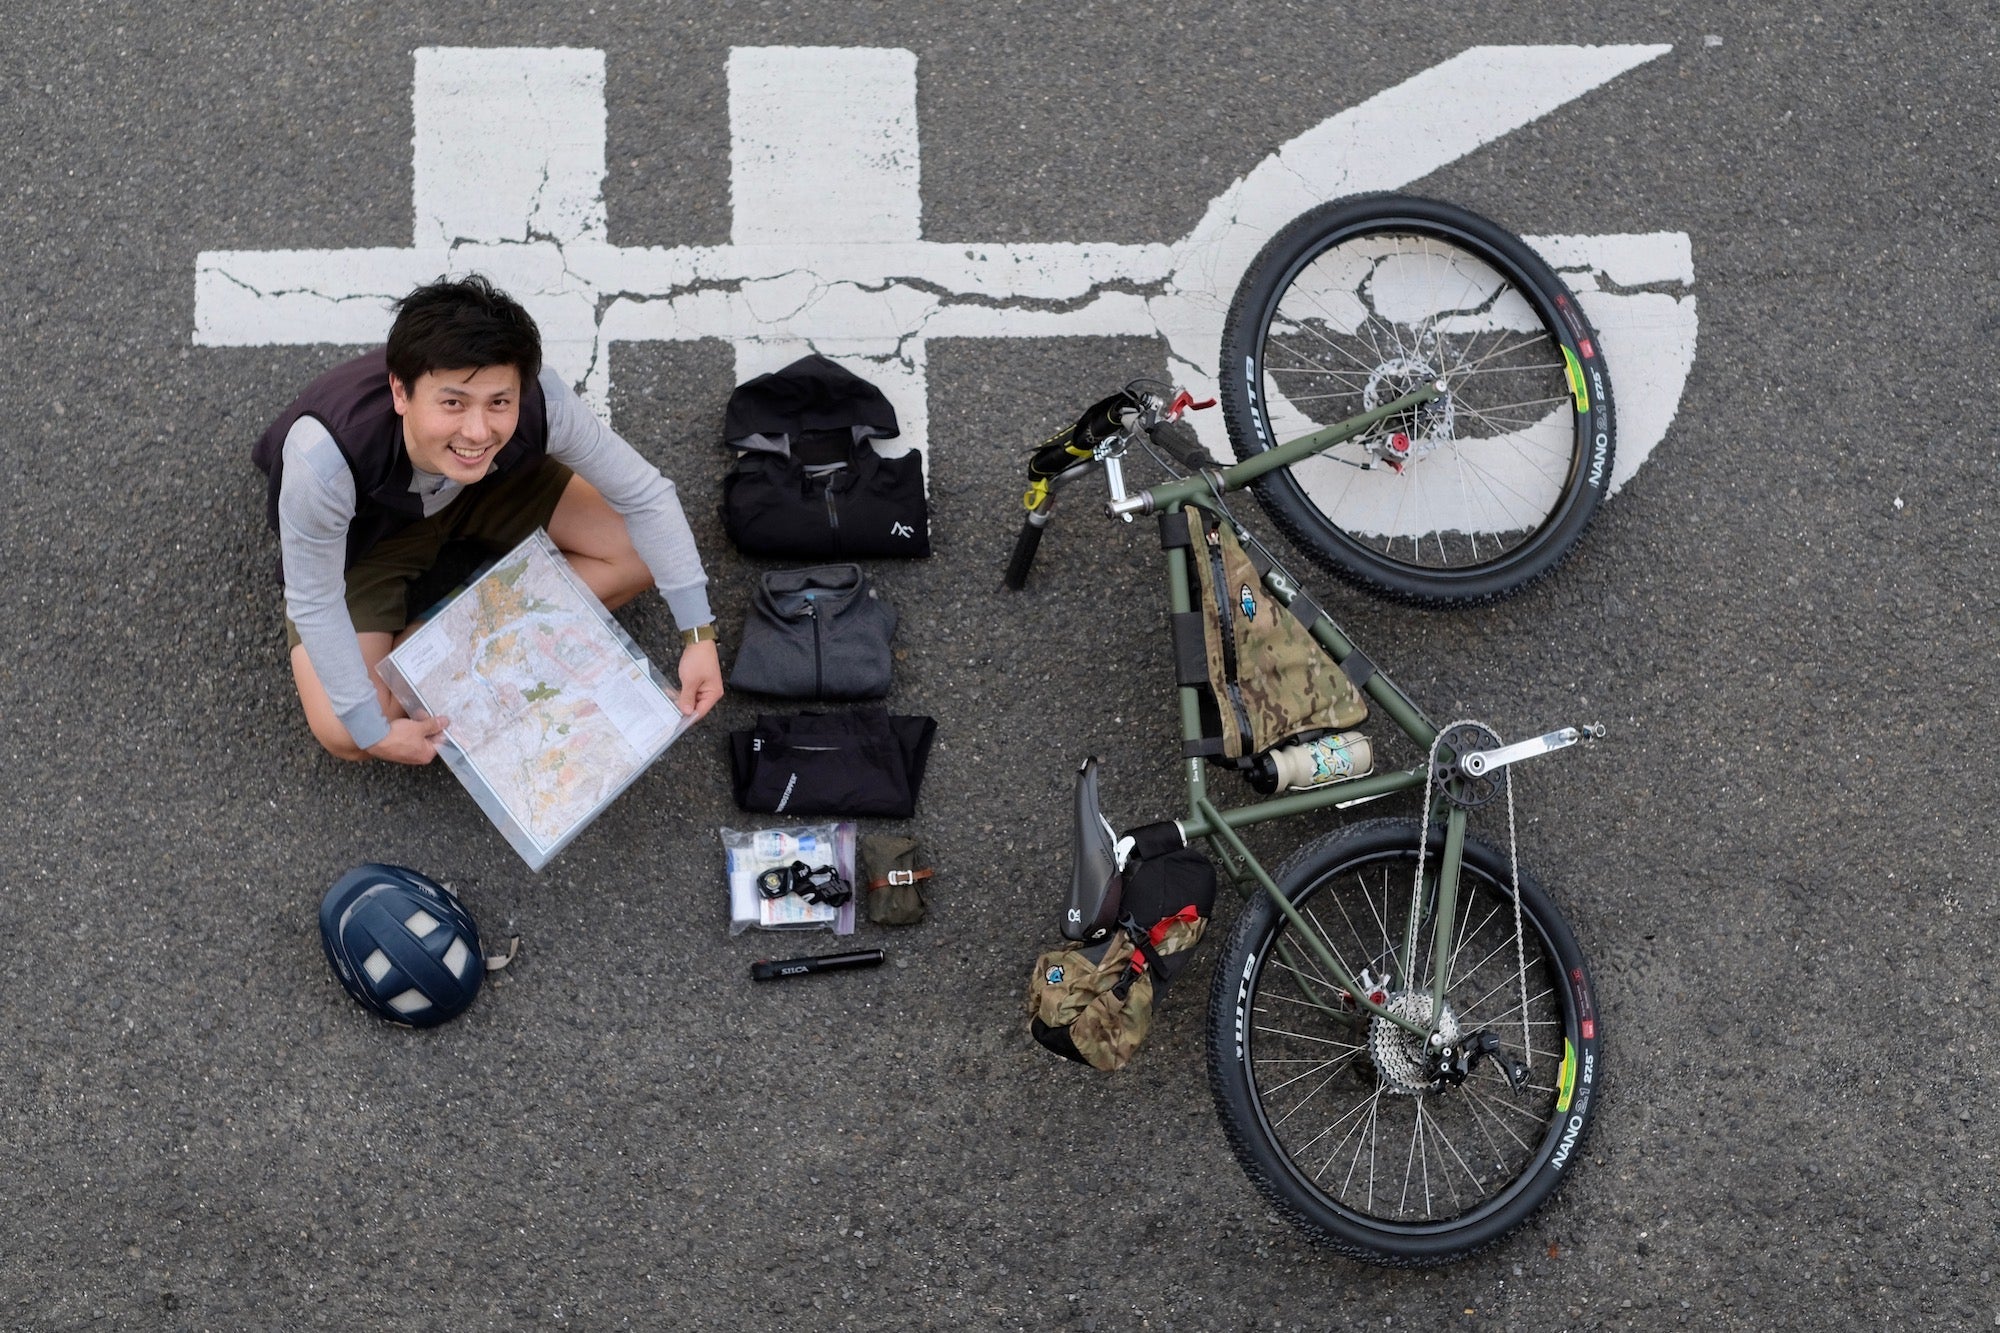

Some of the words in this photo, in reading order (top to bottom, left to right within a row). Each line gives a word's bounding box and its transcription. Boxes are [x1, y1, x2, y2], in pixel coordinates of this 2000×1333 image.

[1245, 355, 1266, 440] WTB
[1595, 404, 1608, 431] 2.1
[1588, 432, 1608, 485] NANO
[781, 965, 809, 976] SILCA
[1235, 953, 1256, 1042] WTB
[1551, 1115, 1583, 1169] NANO
[1575, 1087, 1591, 1114] 2.1
